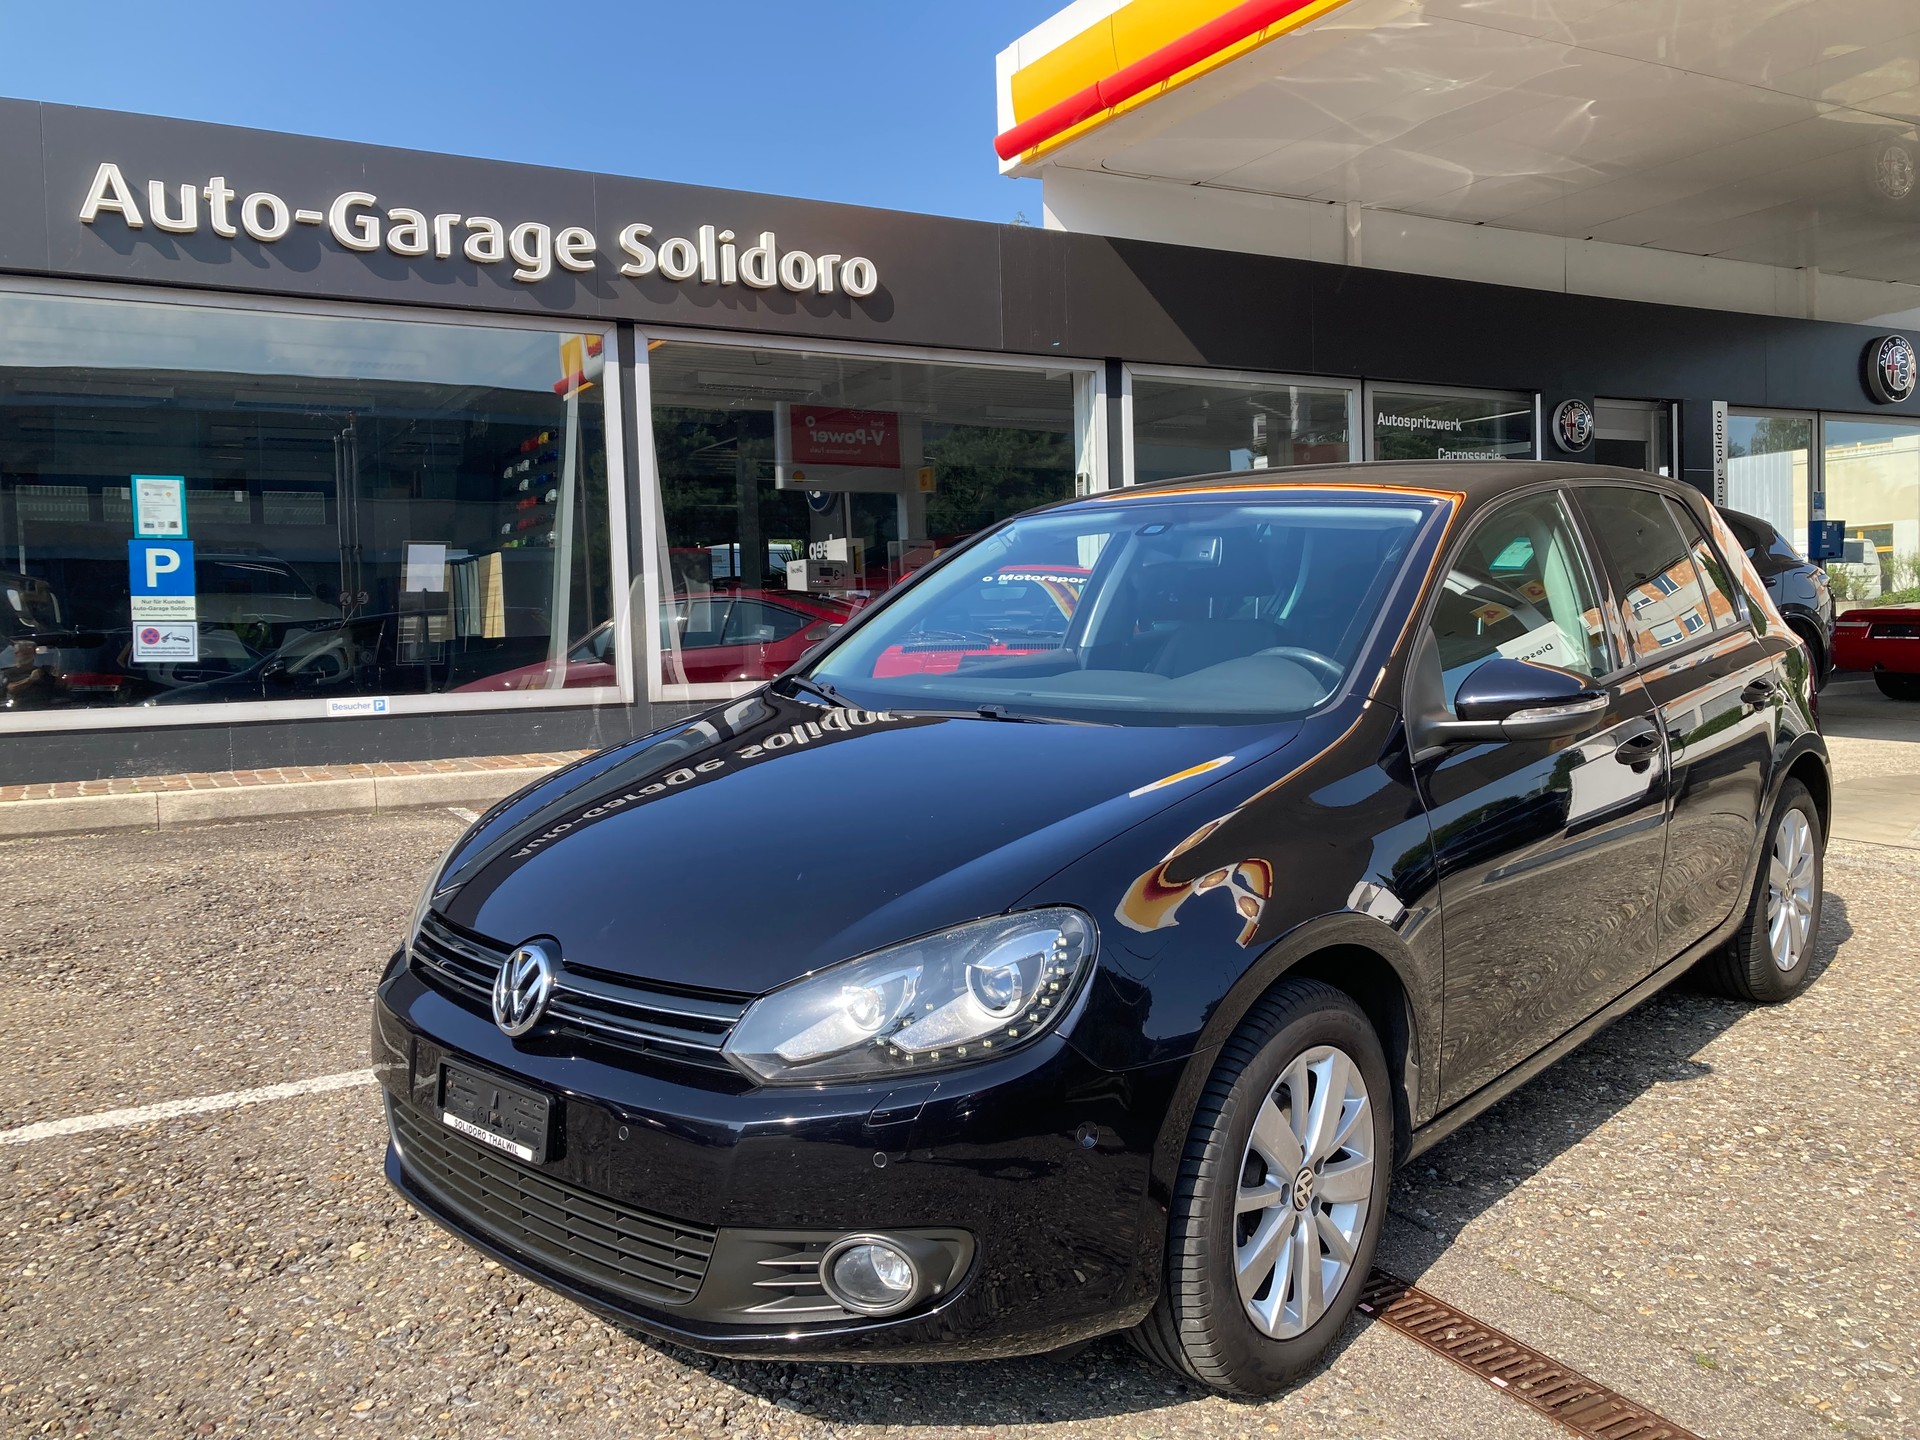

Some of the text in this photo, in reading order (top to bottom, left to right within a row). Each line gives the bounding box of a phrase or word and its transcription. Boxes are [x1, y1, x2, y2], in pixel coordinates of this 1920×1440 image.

[79, 162, 878, 297] Auto-Garage Solidoro
[1880, 341, 1894, 367] ALFA
[1377, 412, 1462, 431] Autospritzwerk
[1560, 404, 1573, 425] ALFA
[1714, 410, 1723, 464] Solidoro
[1438, 448, 1500, 460] Carrosserie
[145, 547, 180, 588] P
[331, 702, 371, 711] Besucher
[454, 1118, 519, 1155] SOLIDORO THALWIL
